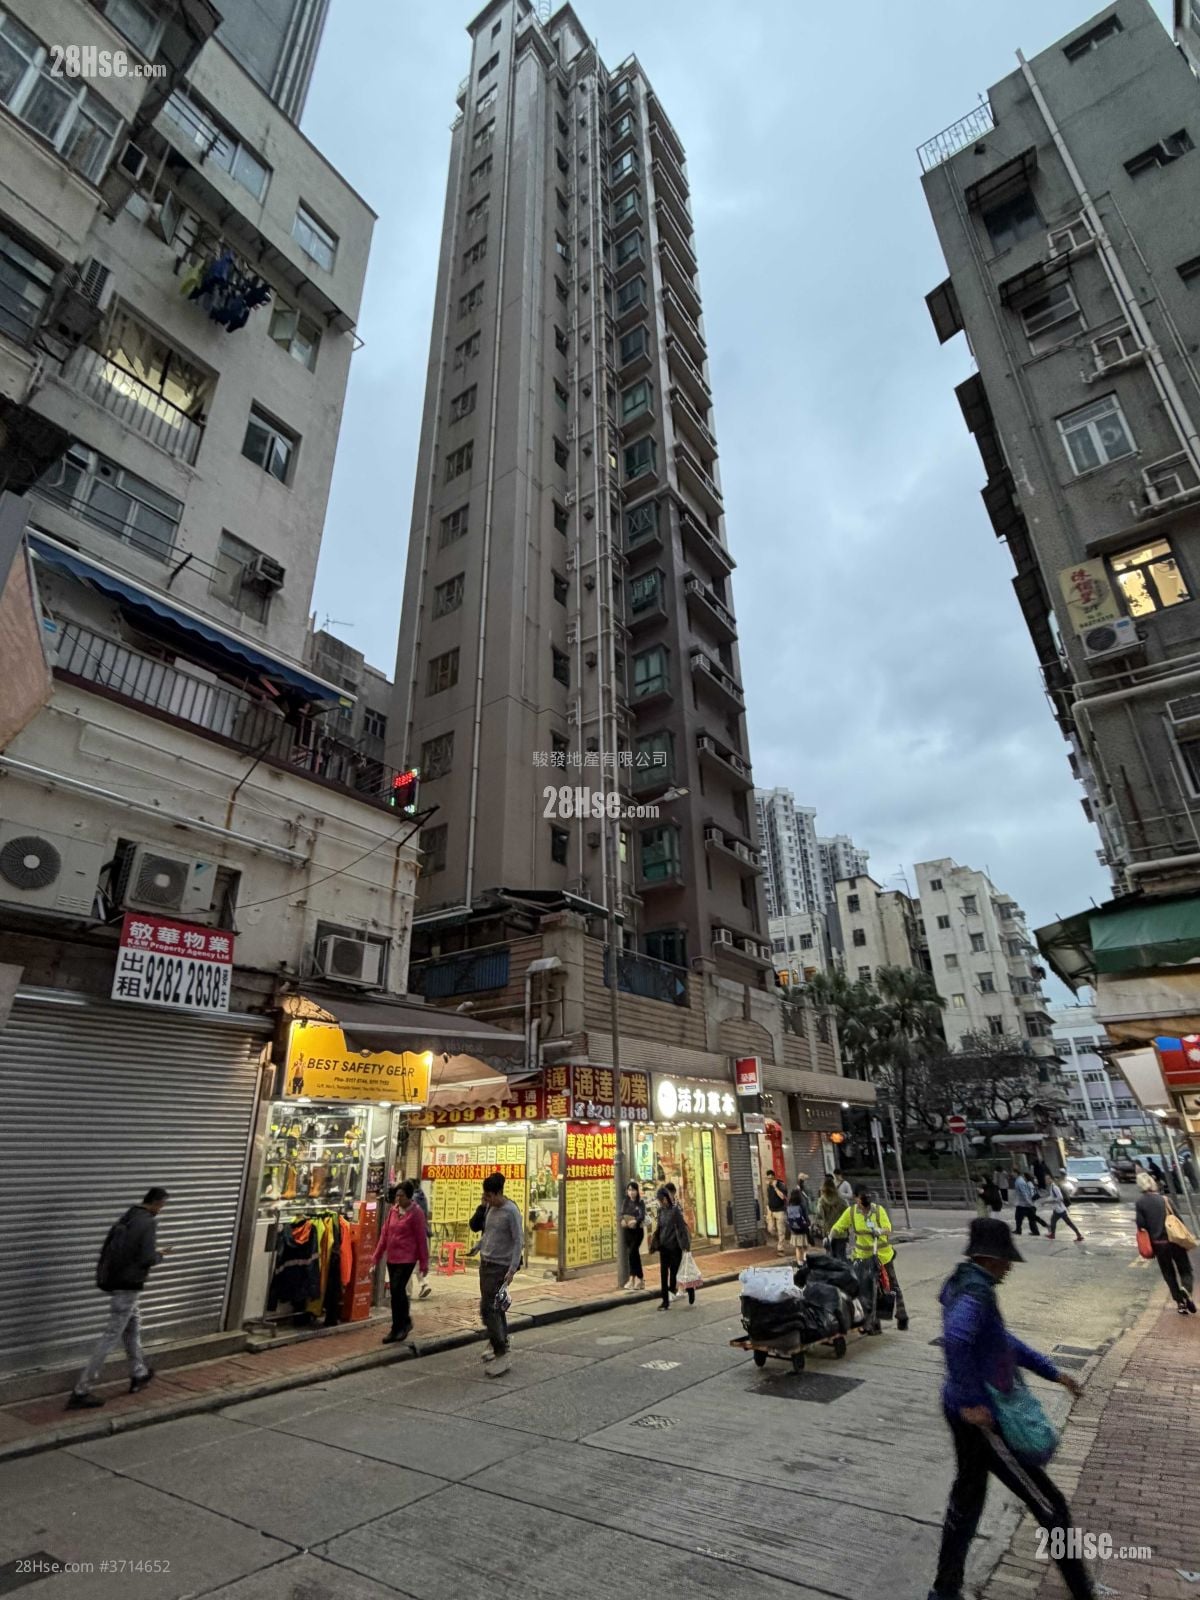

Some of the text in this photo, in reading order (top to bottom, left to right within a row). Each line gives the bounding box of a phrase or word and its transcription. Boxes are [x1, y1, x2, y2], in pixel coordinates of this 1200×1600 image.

[128, 921, 231, 954] 敬華物業
[150, 941, 186, 955] Property
[187, 948, 216, 960] Agency
[116, 952, 144, 998] 出租
[143, 954, 183, 1003] 9282
[184, 961, 221, 1008] 2838
[307, 1057, 415, 1077] BEST SAFETY GEAR
[426, 1104, 538, 1123] 8209 8818
